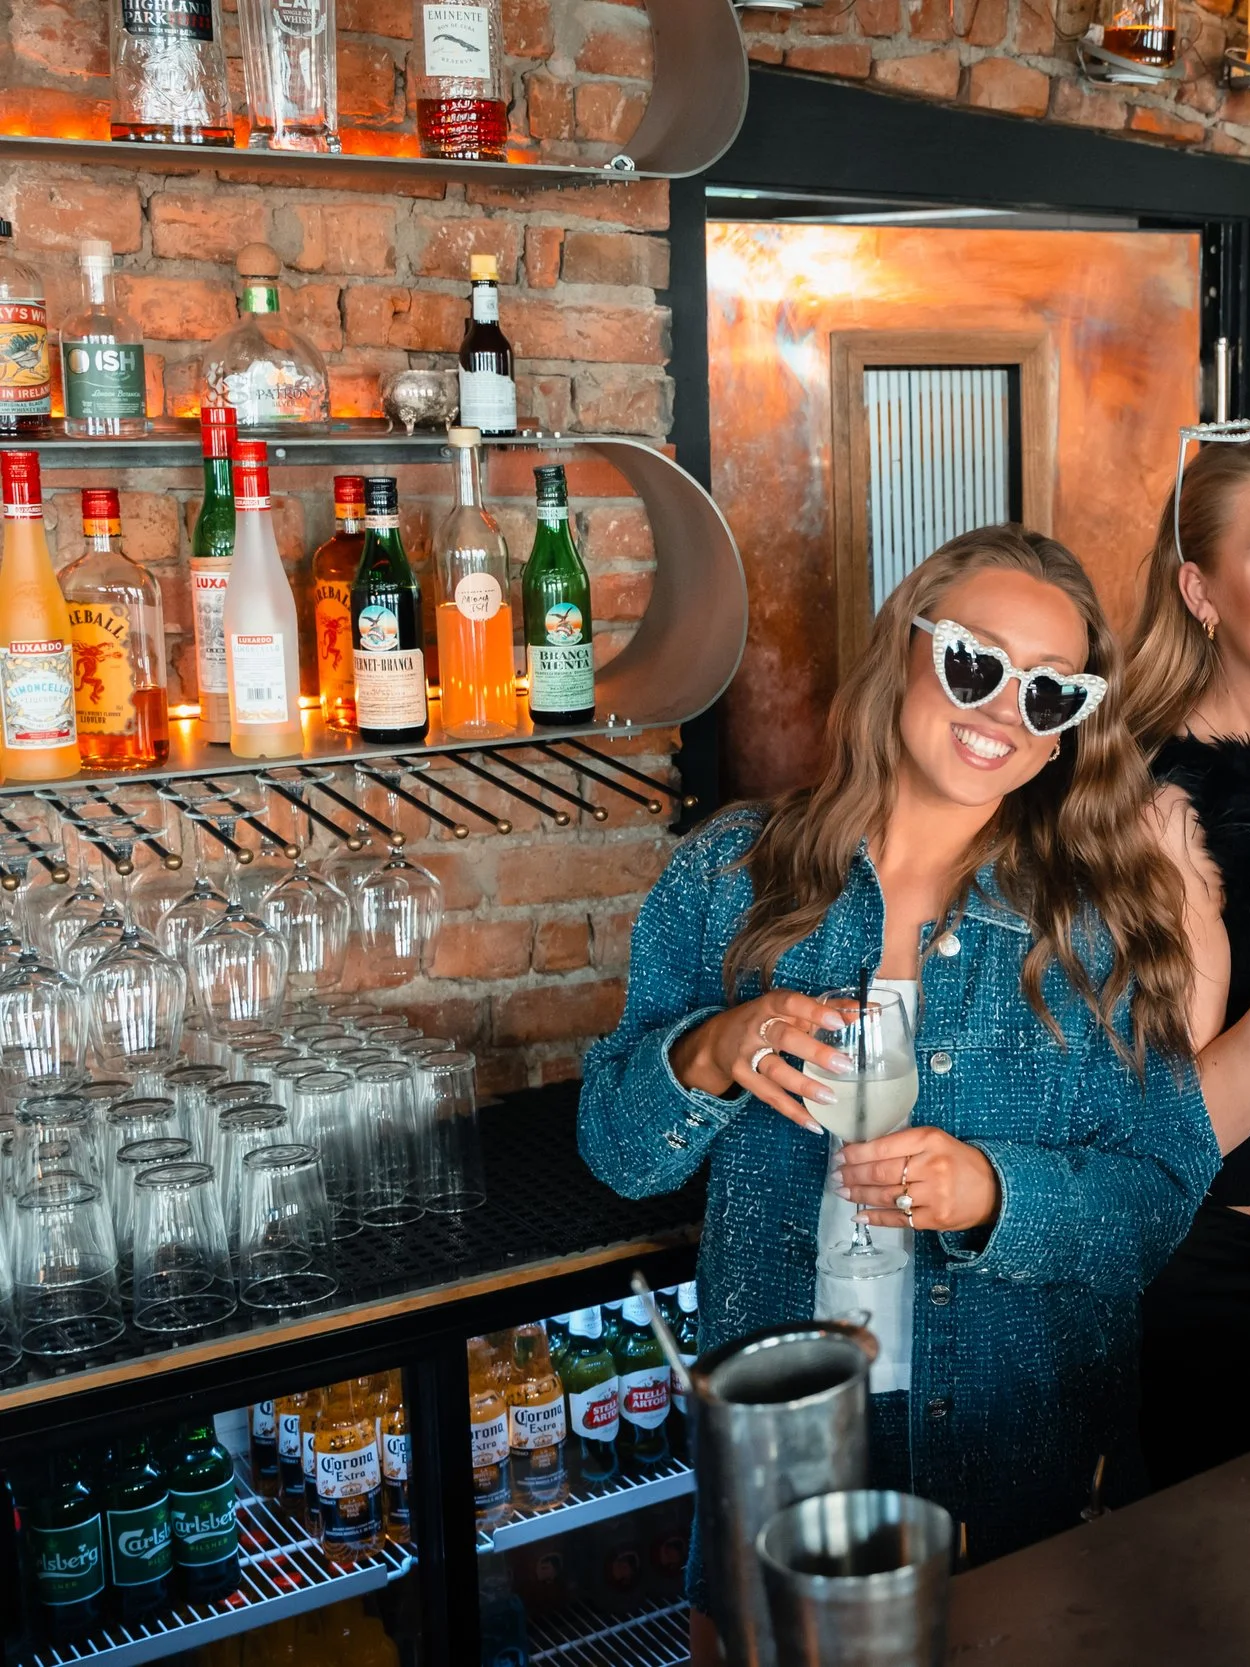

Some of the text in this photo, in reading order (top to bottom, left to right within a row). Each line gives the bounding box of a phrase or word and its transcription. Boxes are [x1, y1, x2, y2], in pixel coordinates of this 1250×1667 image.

[125, 11, 168, 26] PARK
[428, 10, 484, 22] EMINENTE
[94, 350, 136, 371] ISH
[2, 390, 14, 399] IN
[11, 642, 62, 653] LUXARDO
[539, 649, 589, 661] BRANCA
[540, 659, 590, 670] MENTA
[10, 682, 69, 698] LIMONCELLO
[632, 1387, 667, 1400] STELLA
[632, 1395, 668, 1408] ARTOIS
[515, 1404, 563, 1427] Corona
[529, 1422, 556, 1434] Extra
[321, 1451, 373, 1475] Corona
[336, 1470, 366, 1482] Extra
